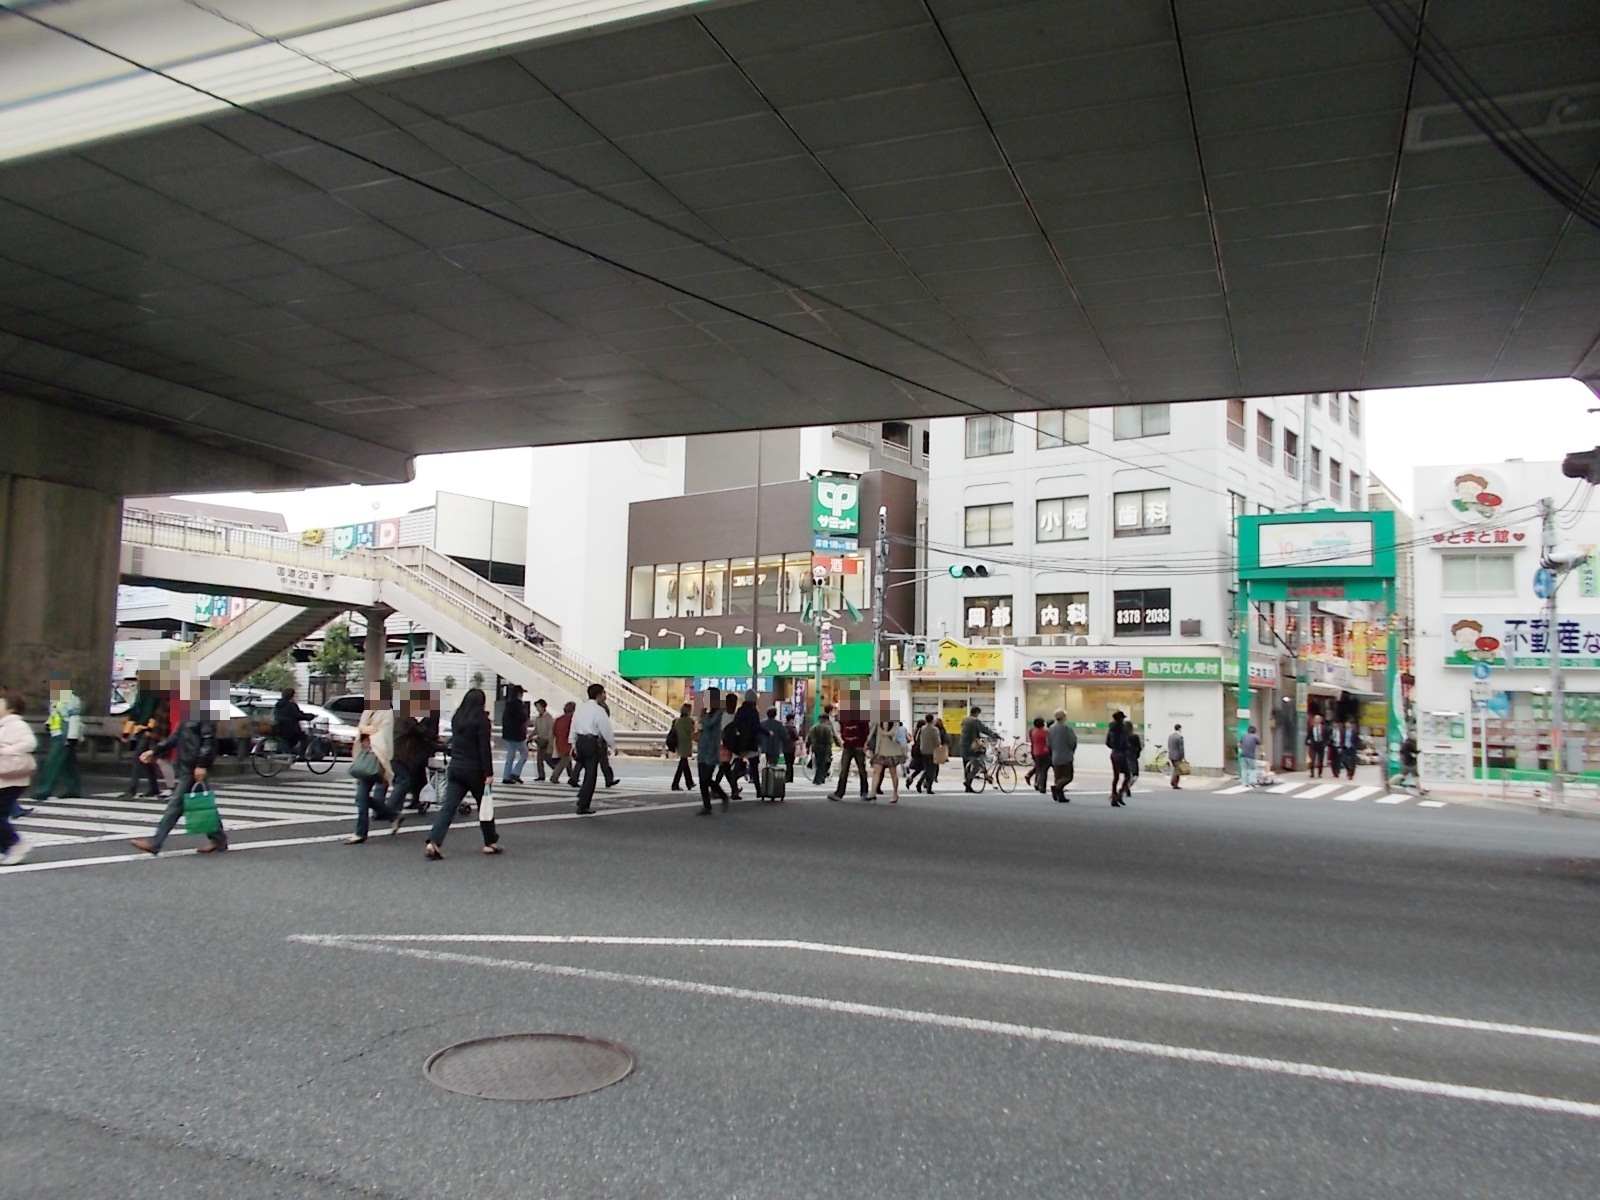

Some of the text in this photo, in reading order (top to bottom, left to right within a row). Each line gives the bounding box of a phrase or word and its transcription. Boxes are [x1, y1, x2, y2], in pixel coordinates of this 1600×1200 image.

[817, 514, 856, 529] サミット
[1447, 529, 1509, 544] とまと館
[830, 558, 843, 572] 酒
[733, 574, 767, 586] コルモア
[1145, 608, 1169, 623] 2033
[1147, 662, 1219, 675] 処方せん受付
